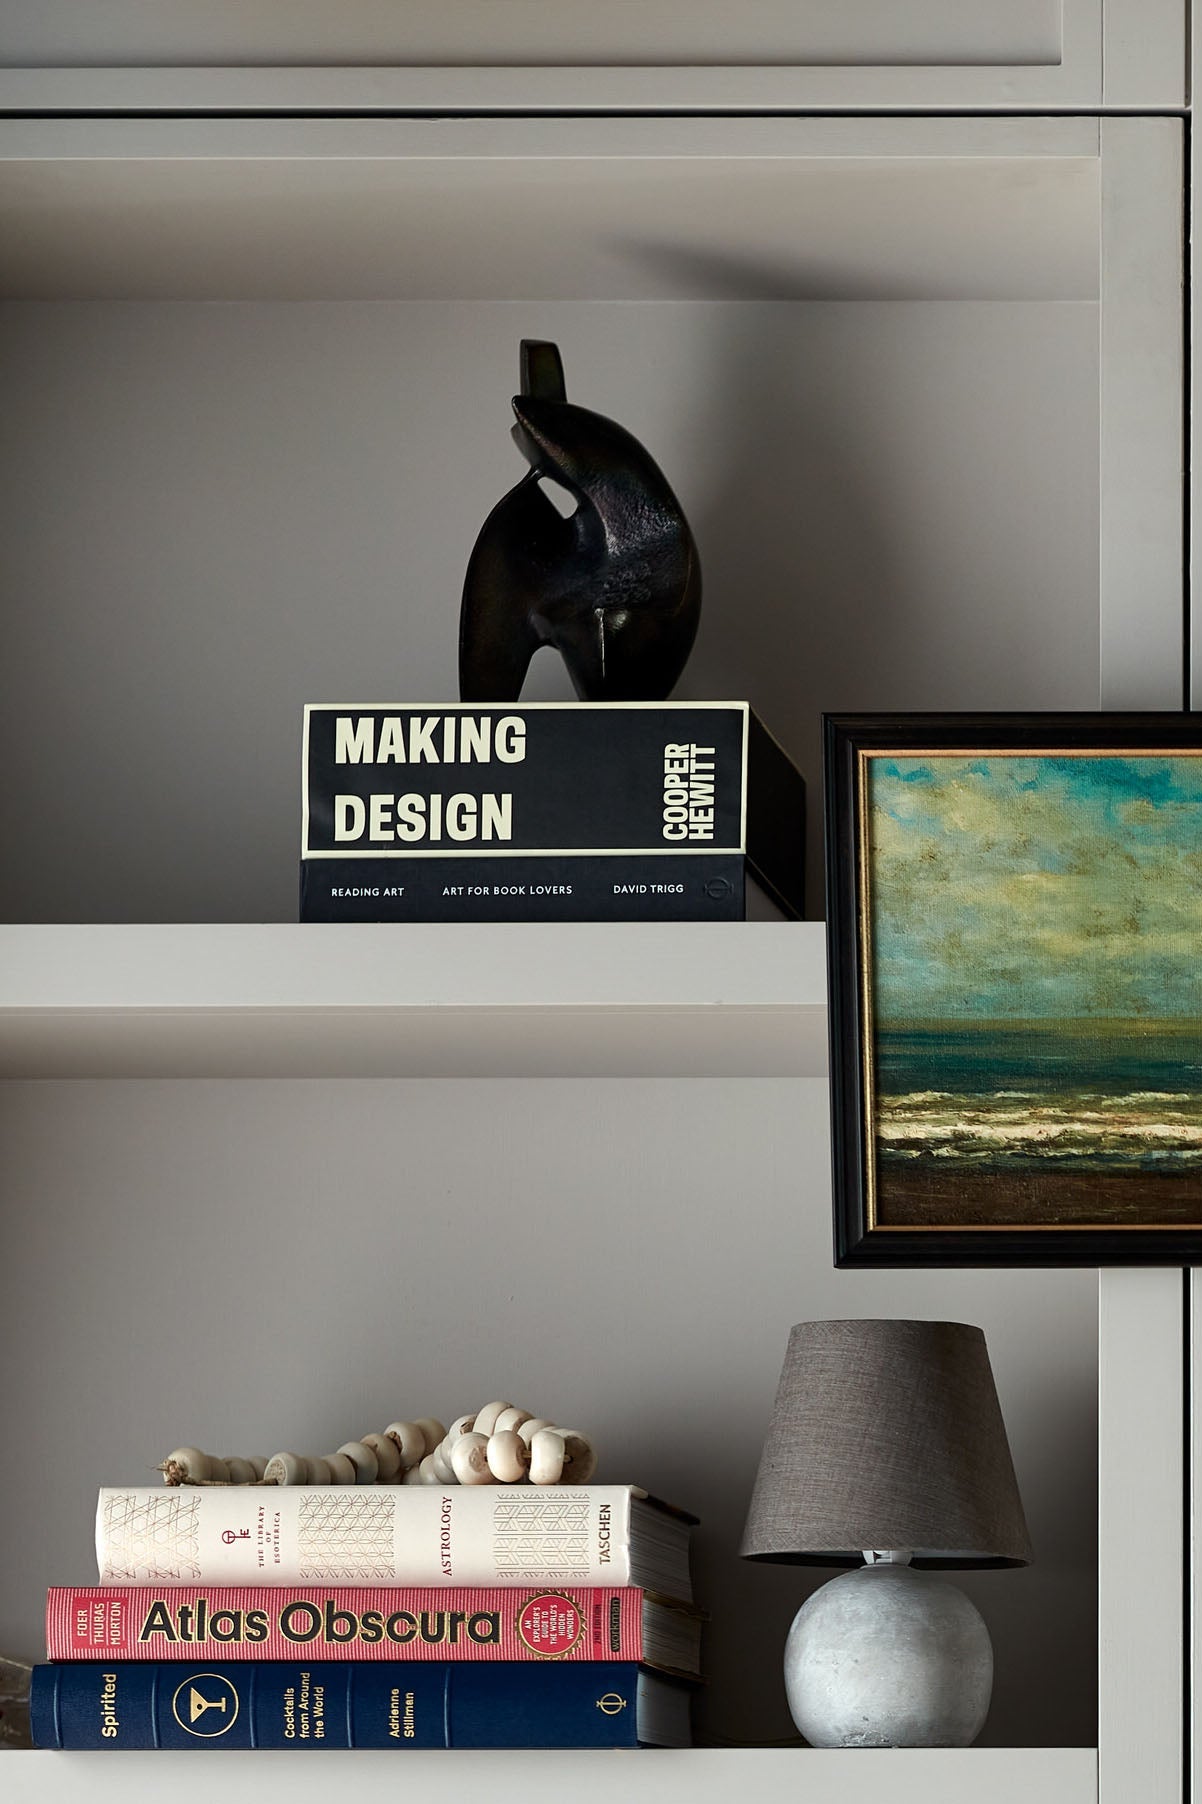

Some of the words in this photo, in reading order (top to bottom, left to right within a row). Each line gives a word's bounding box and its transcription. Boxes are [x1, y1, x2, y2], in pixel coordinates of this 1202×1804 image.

[335, 716, 526, 764] MAKING
[662, 743, 690, 840] COOPER
[689, 743, 715, 840] HEWITT
[334, 794, 512, 841] DESIGN
[331, 887, 380, 897] READING
[383, 887, 404, 896] ART
[442, 886, 464, 896] ART
[467, 886, 490, 895] FOR
[493, 886, 526, 895] BOOK
[529, 885, 573, 895] LOVERS
[613, 884, 647, 894] DAVID
[650, 884, 684, 894] TRIGG
[266, 1531, 272, 1543] OF
[441, 1496, 453, 1577] ASTROLOGY
[599, 1504, 611, 1564] TASCHEN
[78, 1609, 88, 1636] FOER
[94, 1602, 105, 1644] THURAS
[111, 1602, 121, 1645] MORTON
[138, 1598, 270, 1644] Atlas
[278, 1599, 500, 1645] Obscura
[525, 1620, 532, 1629] AN
[533, 1606, 541, 1643] EXPLORER'S
[542, 1611, 549, 1621] TO
[550, 1604, 558, 1630] WORLD'S
[558, 1613, 566, 1636] HIDDEN
[610, 1599, 620, 1651] workman
[100, 1673, 119, 1738] Spirited
[300, 1672, 310, 1710] Around
[314, 1686, 325, 1719] World
[284, 1688, 295, 1738] Cocktails
[300, 1712, 310, 1738] from
[314, 1721, 325, 1738] the
[389, 1688, 400, 1738] Adrienne
[404, 1692, 414, 1738] Stillman
